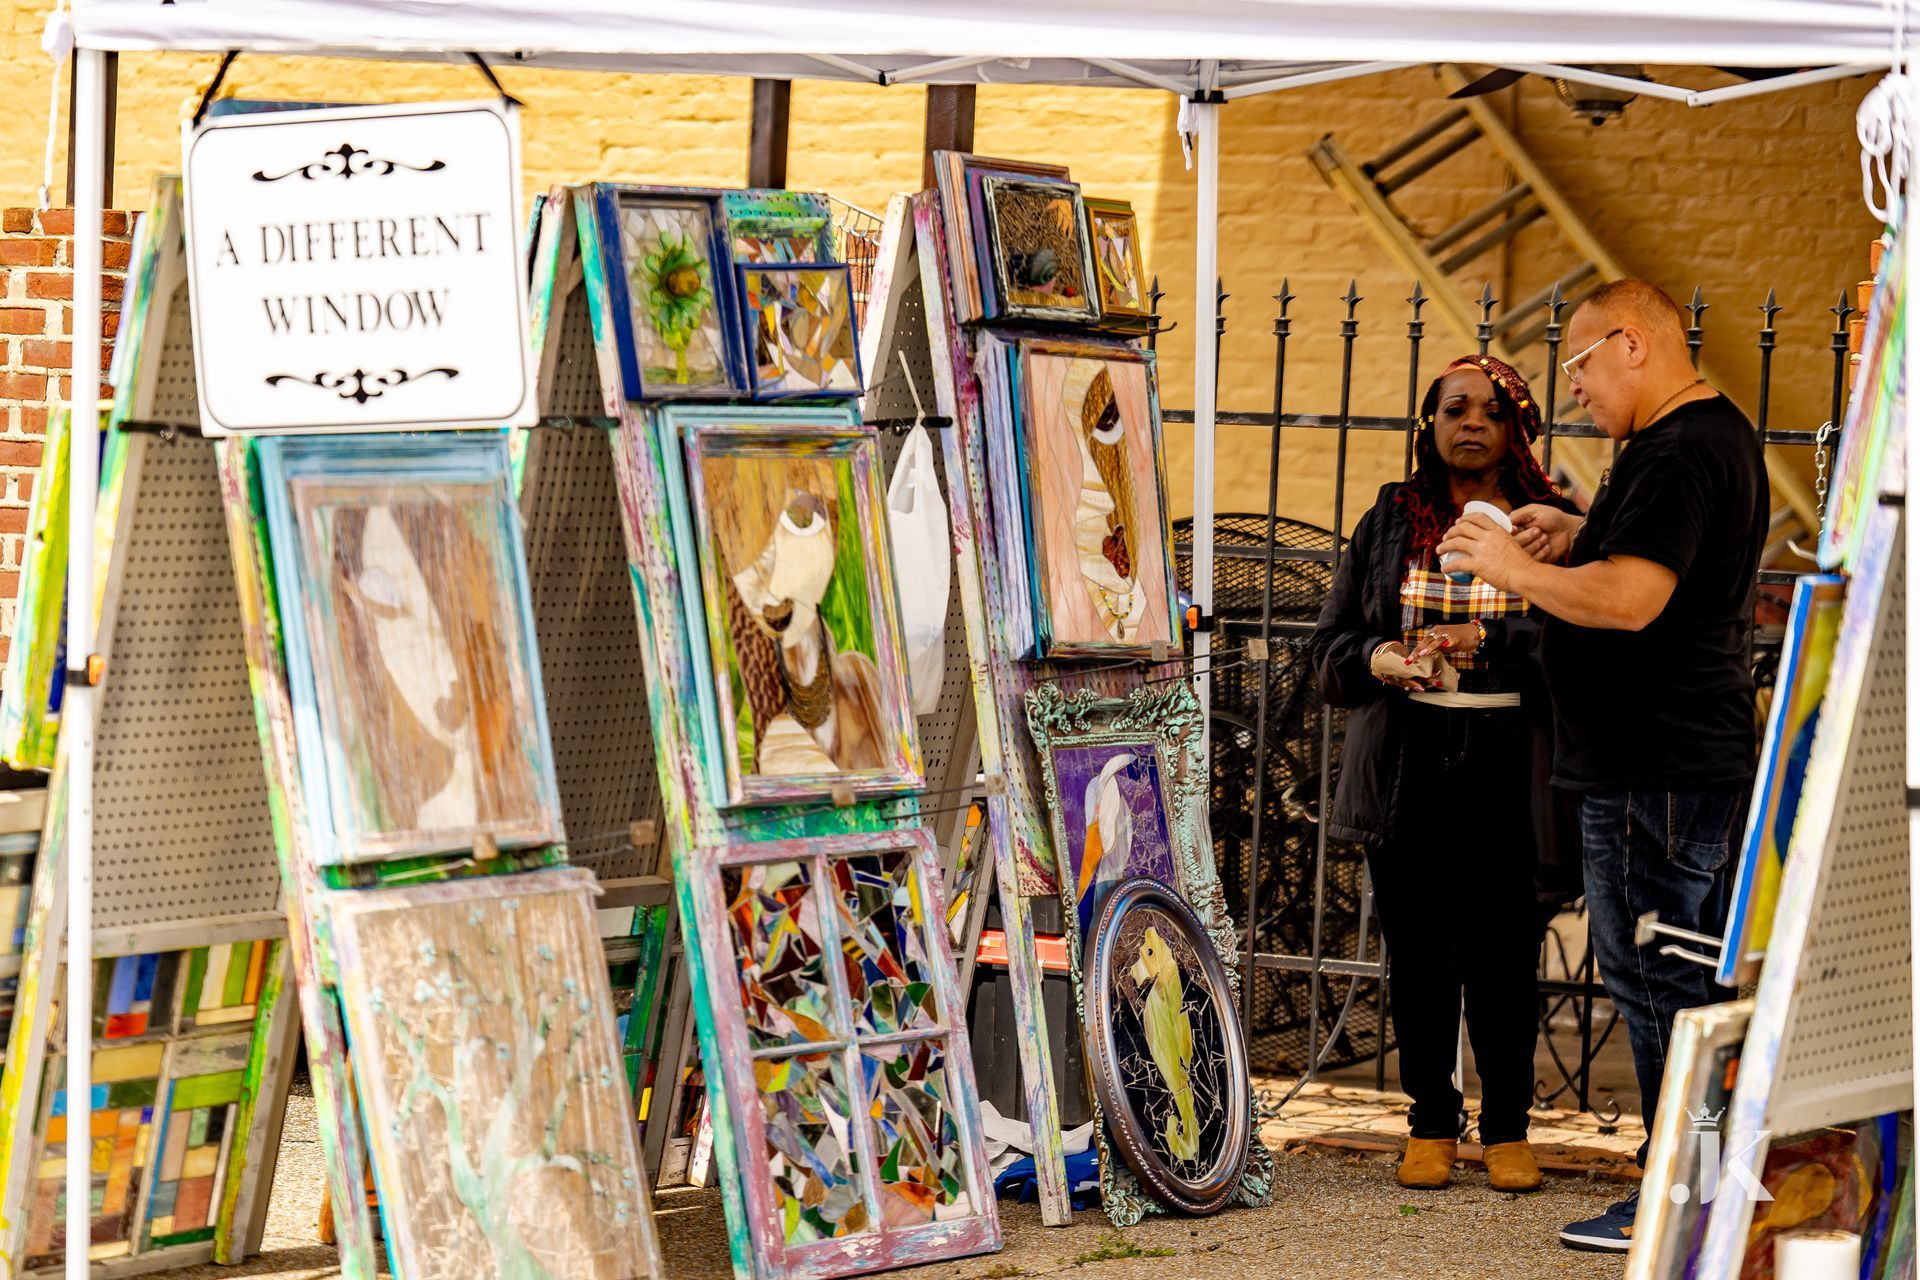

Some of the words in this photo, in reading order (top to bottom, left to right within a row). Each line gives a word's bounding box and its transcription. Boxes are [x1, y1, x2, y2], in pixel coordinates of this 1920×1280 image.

[215, 229, 241, 268] A
[260, 211, 492, 265] DIFFERENT
[261, 287, 451, 336] WINDOW
